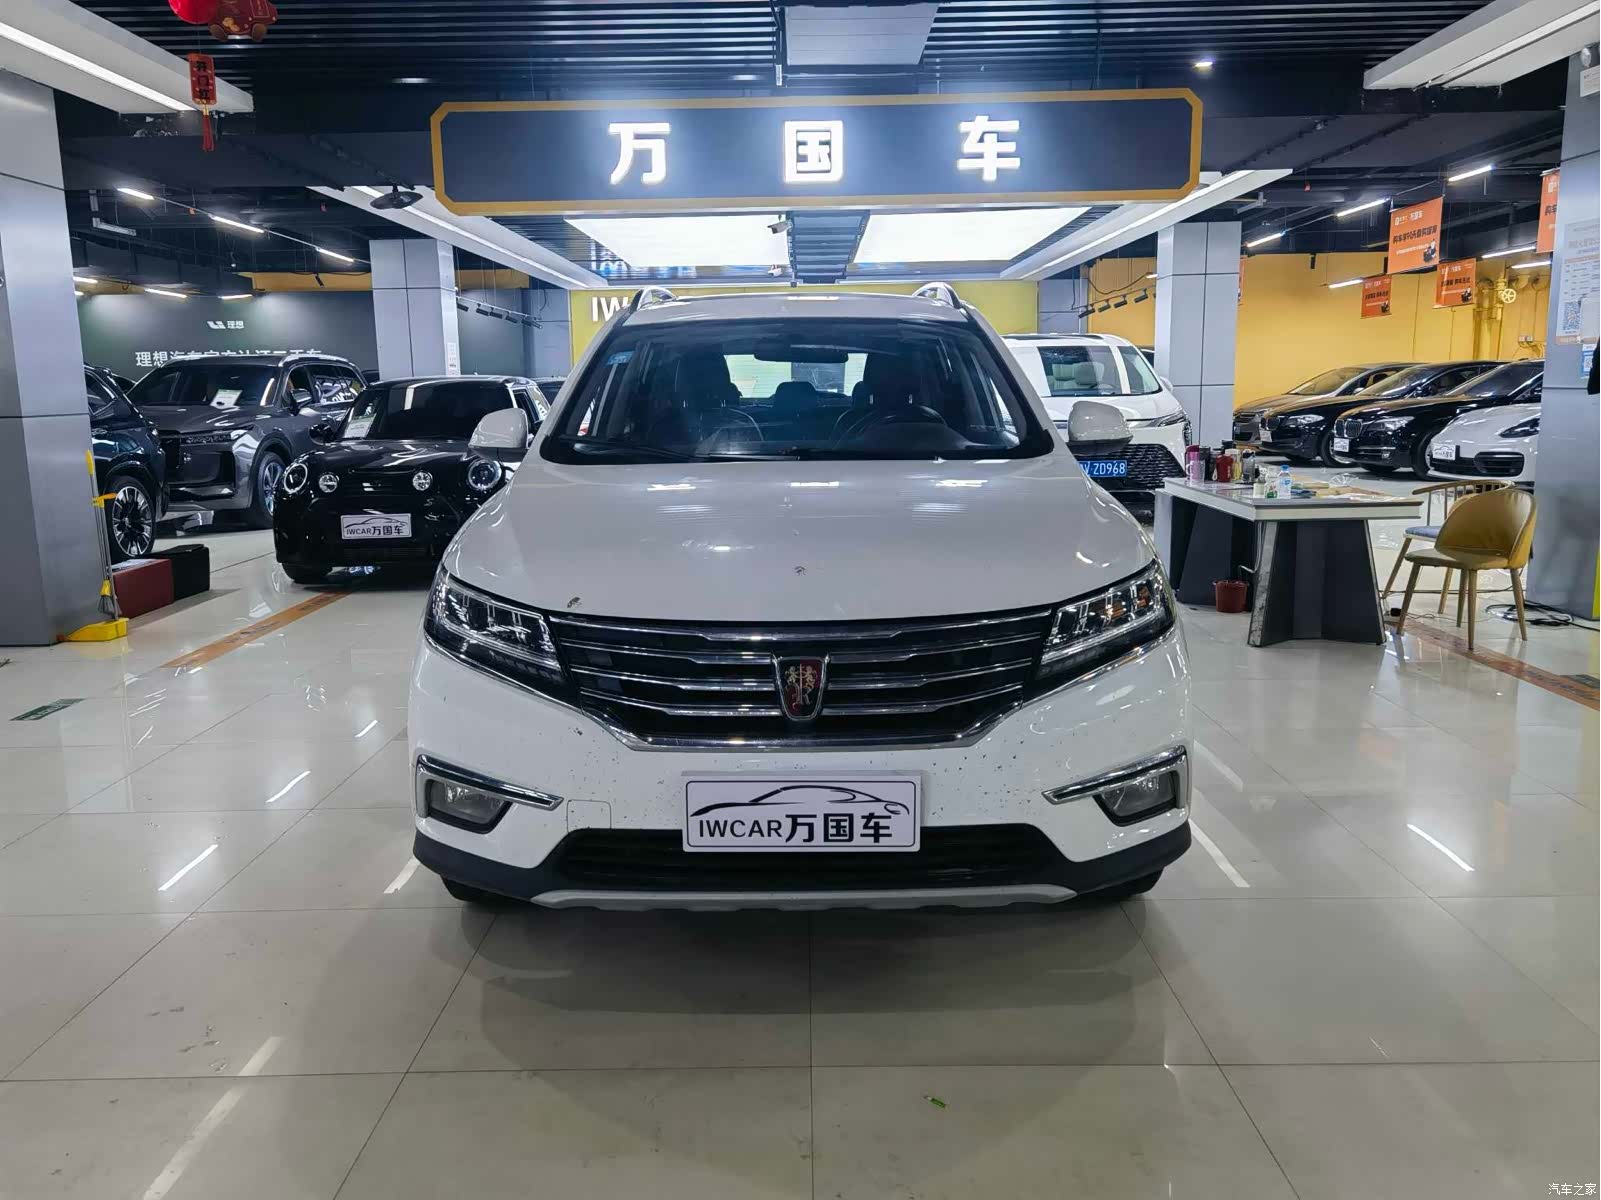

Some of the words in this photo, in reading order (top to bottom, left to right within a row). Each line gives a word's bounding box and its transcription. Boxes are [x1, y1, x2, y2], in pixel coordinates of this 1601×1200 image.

[608, 115, 1021, 184] 万国车
[227, 320, 244, 329] 理想
